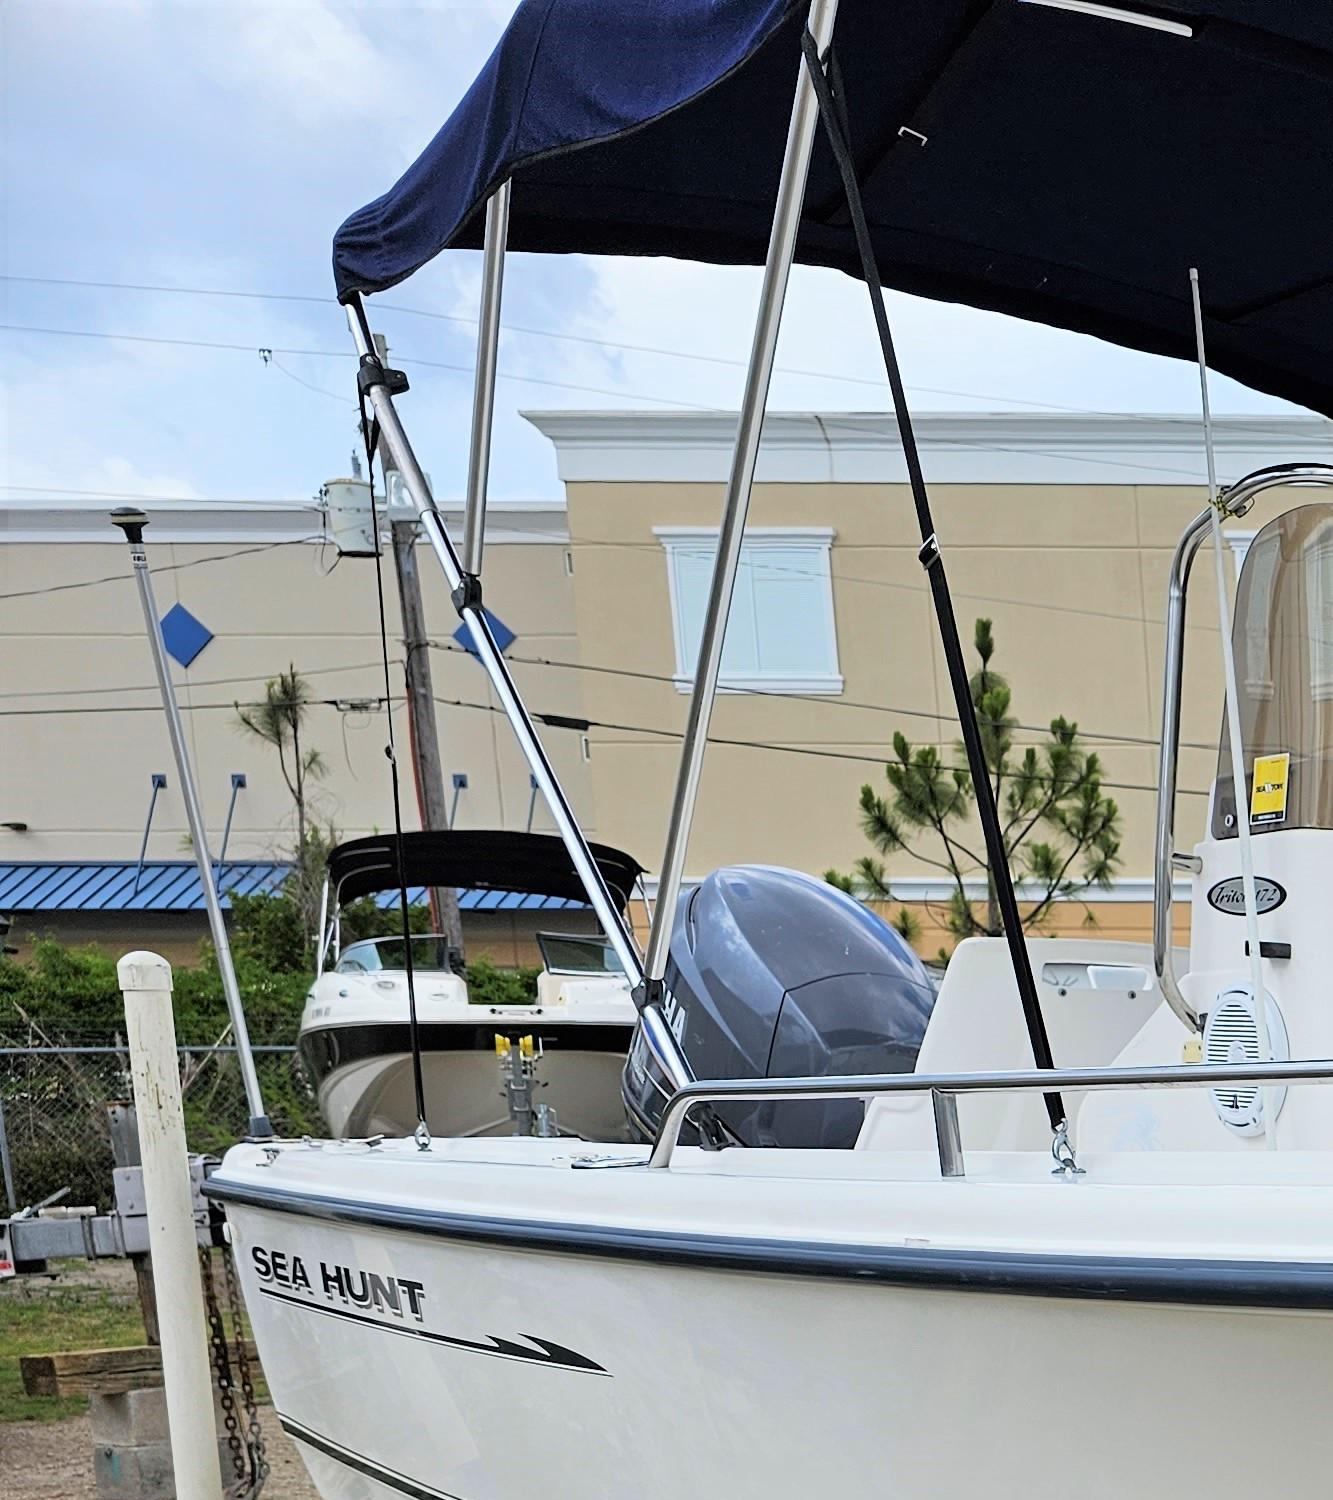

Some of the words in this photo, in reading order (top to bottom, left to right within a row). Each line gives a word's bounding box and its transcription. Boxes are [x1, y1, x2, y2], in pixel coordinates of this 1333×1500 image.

[1214, 886, 1246, 904] Trito
[252, 1246, 313, 1293] SEA
[320, 1261, 425, 1321] HUNT
